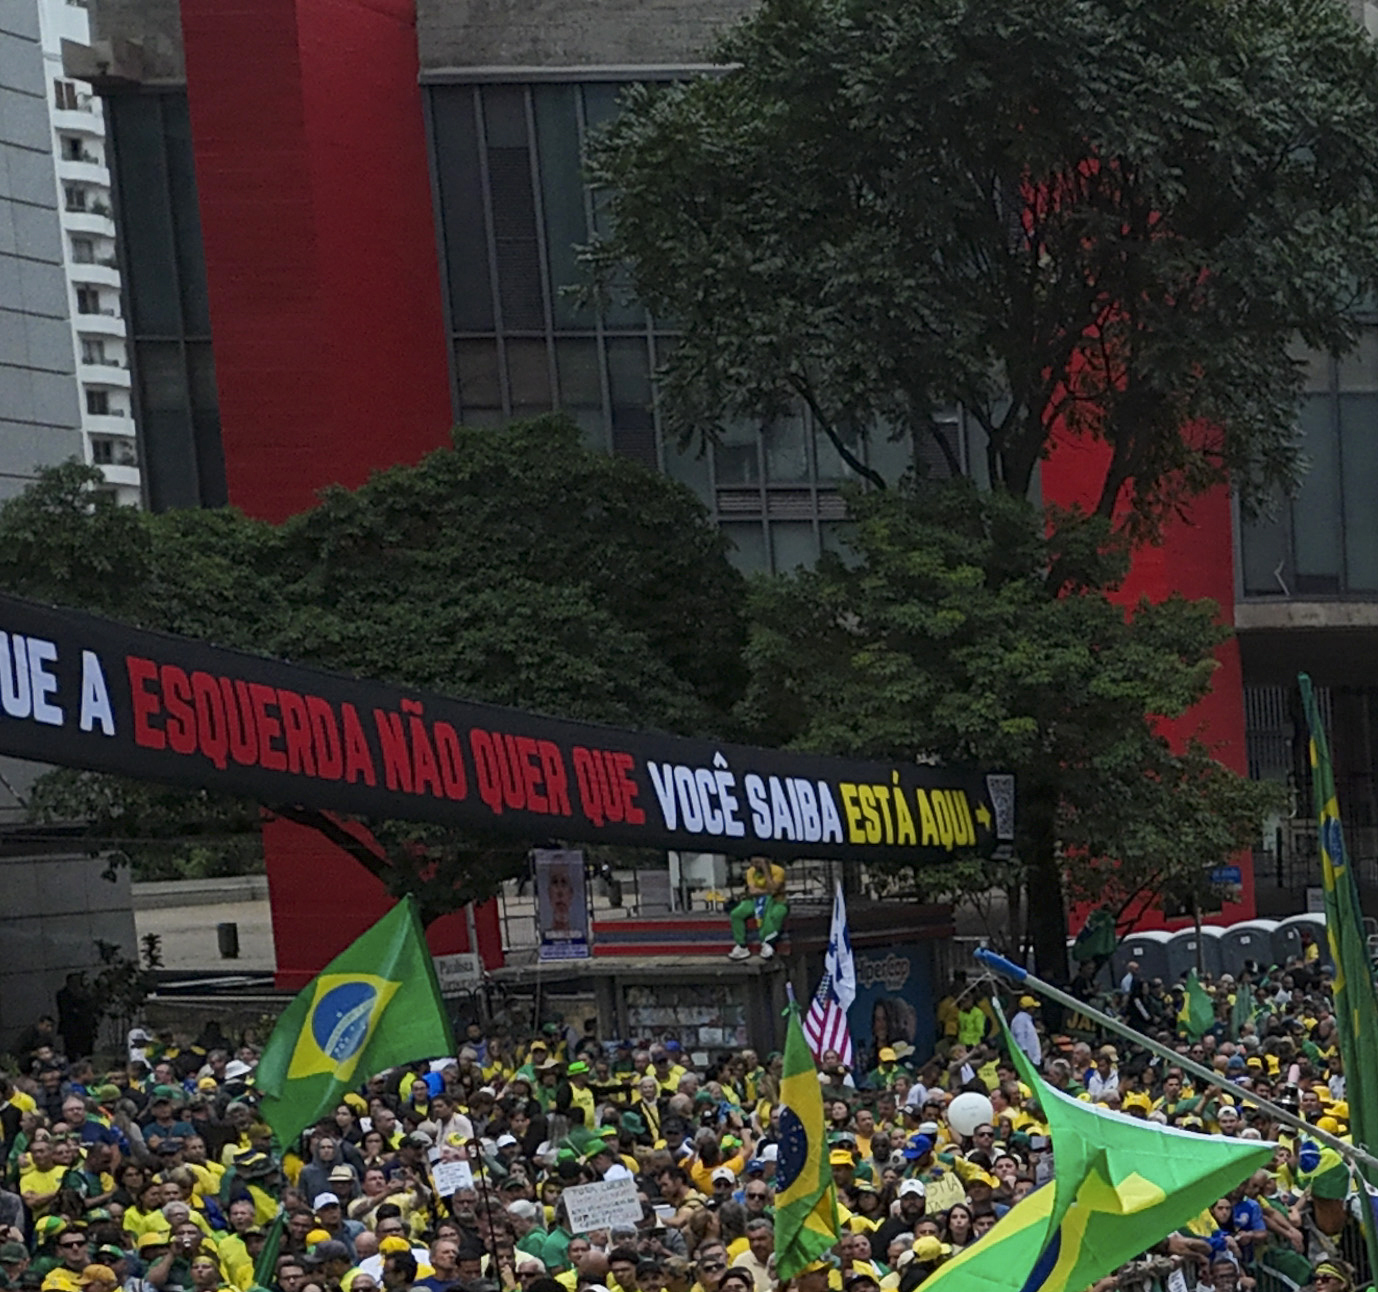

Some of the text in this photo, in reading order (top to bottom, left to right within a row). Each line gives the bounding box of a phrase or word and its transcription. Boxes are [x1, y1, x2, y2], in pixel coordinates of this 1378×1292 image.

[78, 649, 115, 735] A
[125, 654, 374, 786] ESQUERDA
[372, 698, 465, 799] NÃO
[469, 727, 572, 817] QUER
[572, 746, 645, 827] QUE
[648, 750, 745, 836] VOCÊ
[743, 773, 844, 843] SAIBA
[839, 770, 916, 845] ESTÁ
[916, 788, 977, 852] AQUI
